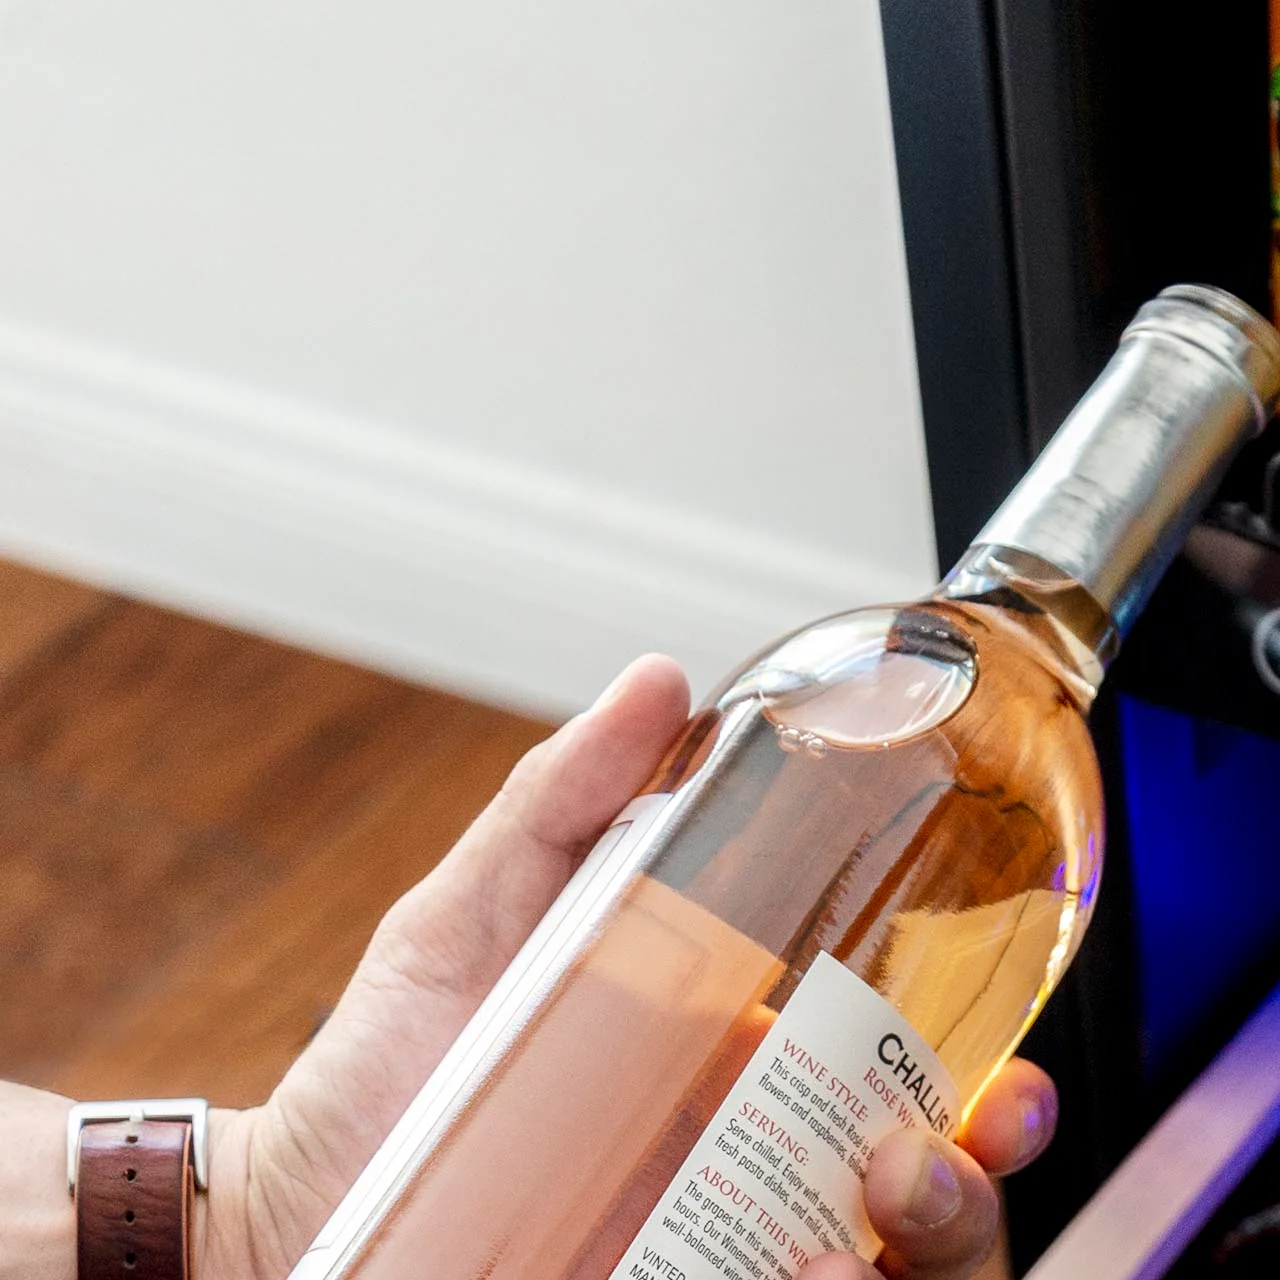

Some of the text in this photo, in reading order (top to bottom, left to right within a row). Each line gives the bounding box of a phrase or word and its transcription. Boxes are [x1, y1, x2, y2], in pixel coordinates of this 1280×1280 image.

[758, 1073, 792, 1106] flowers
[790, 1102, 811, 1120] and
[807, 1116, 848, 1161] raspberries,
[769, 1057, 791, 1080] This
[789, 1076, 811, 1098] crisp
[810, 1093, 831, 1112] and
[826, 1104, 848, 1131] fresh
[844, 1123, 866, 1148] Rosé
[782, 1038, 868, 1122] WINE STYLE:
[863, 1066, 900, 1109] ROSÉ
[877, 1033, 951, 1136] CHALLIS
[714, 1133, 740, 1159] fresh
[736, 1155, 765, 1180] pasta
[763, 1175, 790, 1206] dishes,
[790, 1202, 808, 1219] and
[725, 1118, 752, 1145] Serve
[751, 1139, 784, 1170] chilled.
[781, 1163, 805, 1192] Enjoy
[802, 1185, 820, 1205] with
[738, 1101, 809, 1166] SERVING:
[662, 1215, 727, 1269] well-balanced
[672, 1196, 701, 1226] hours.
[703, 1220, 721, 1240] Our
[720, 1233, 764, 1280] Winemaker
[684, 1179, 703, 1201] The
[701, 1198, 733, 1226] grapes
[732, 1218, 747, 1237] for
[744, 1231, 762, 1251] this
[759, 1246, 779, 1268] wine
[696, 1165, 809, 1269] ABOUT THIS WIN
